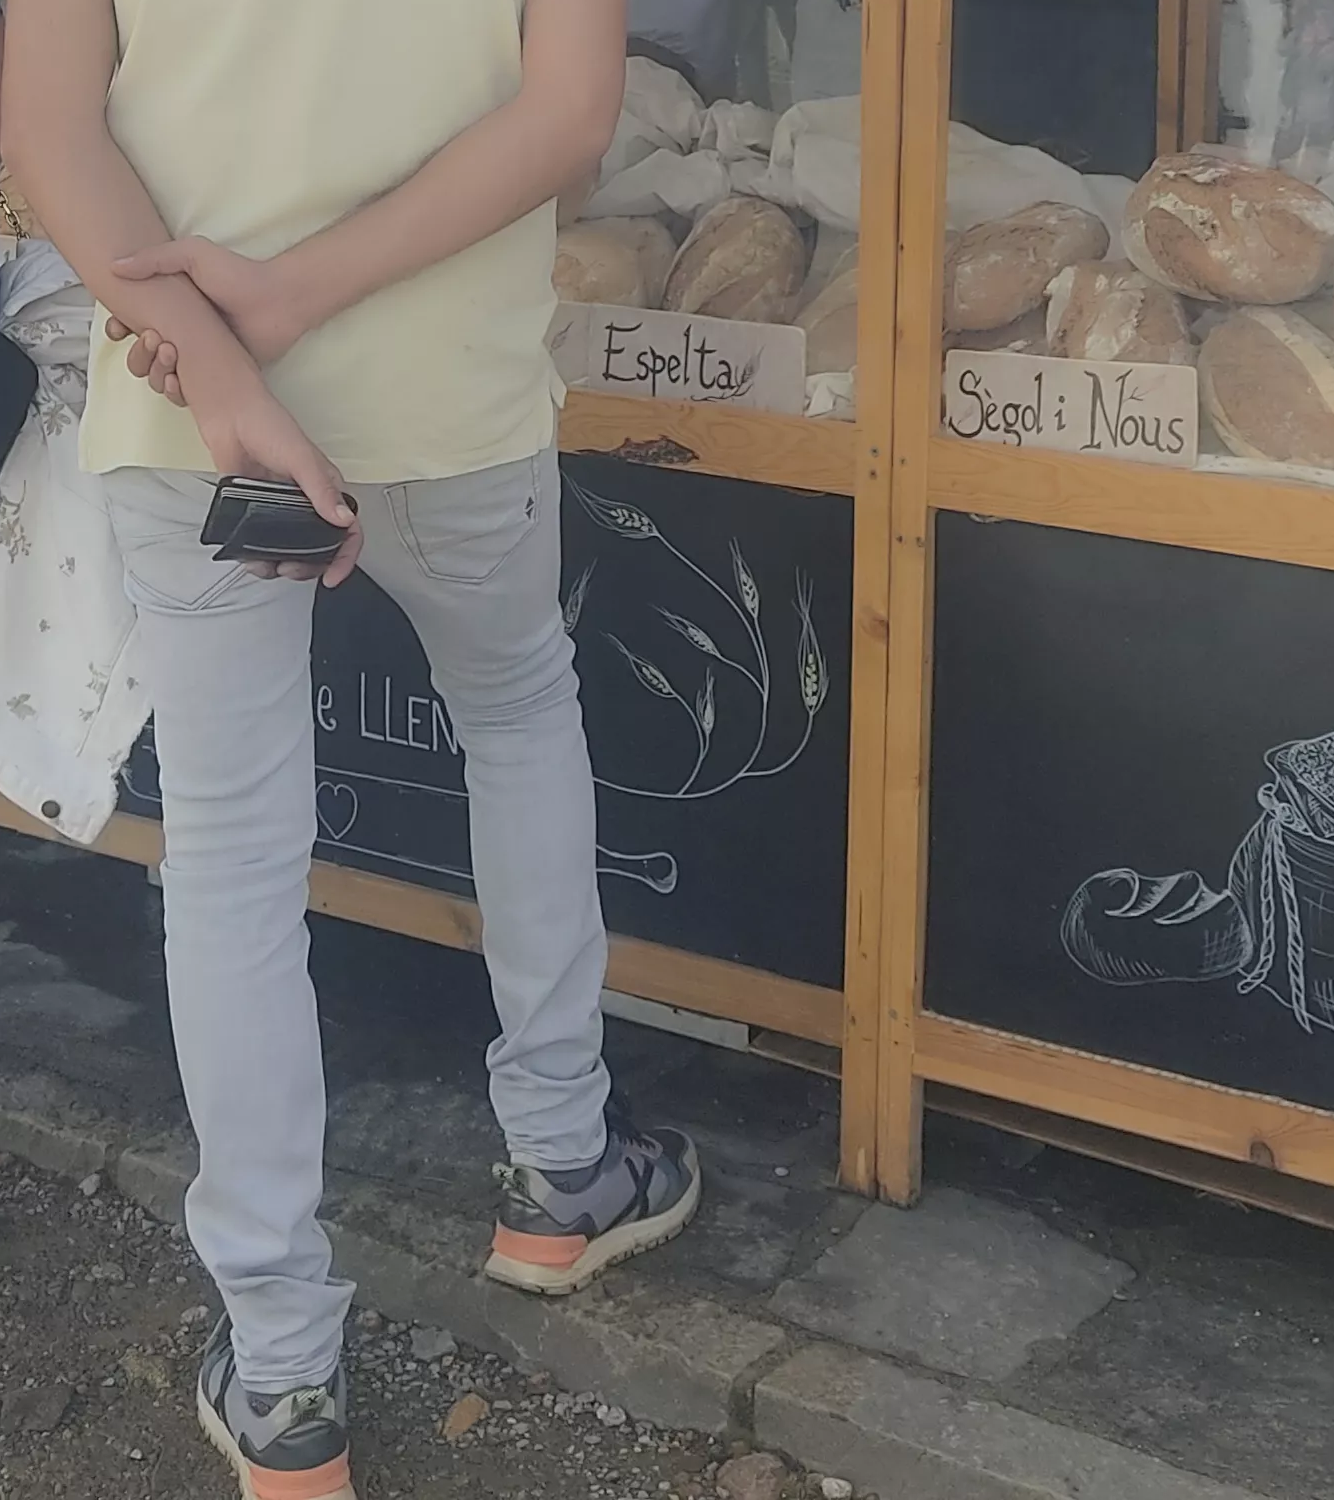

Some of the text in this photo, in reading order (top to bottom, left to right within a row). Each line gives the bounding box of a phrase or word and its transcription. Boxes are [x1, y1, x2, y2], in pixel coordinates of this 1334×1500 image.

[602, 321, 737, 396] Espelta
[1054, 395, 1067, 431] i
[1079, 368, 1184, 454] Nous
